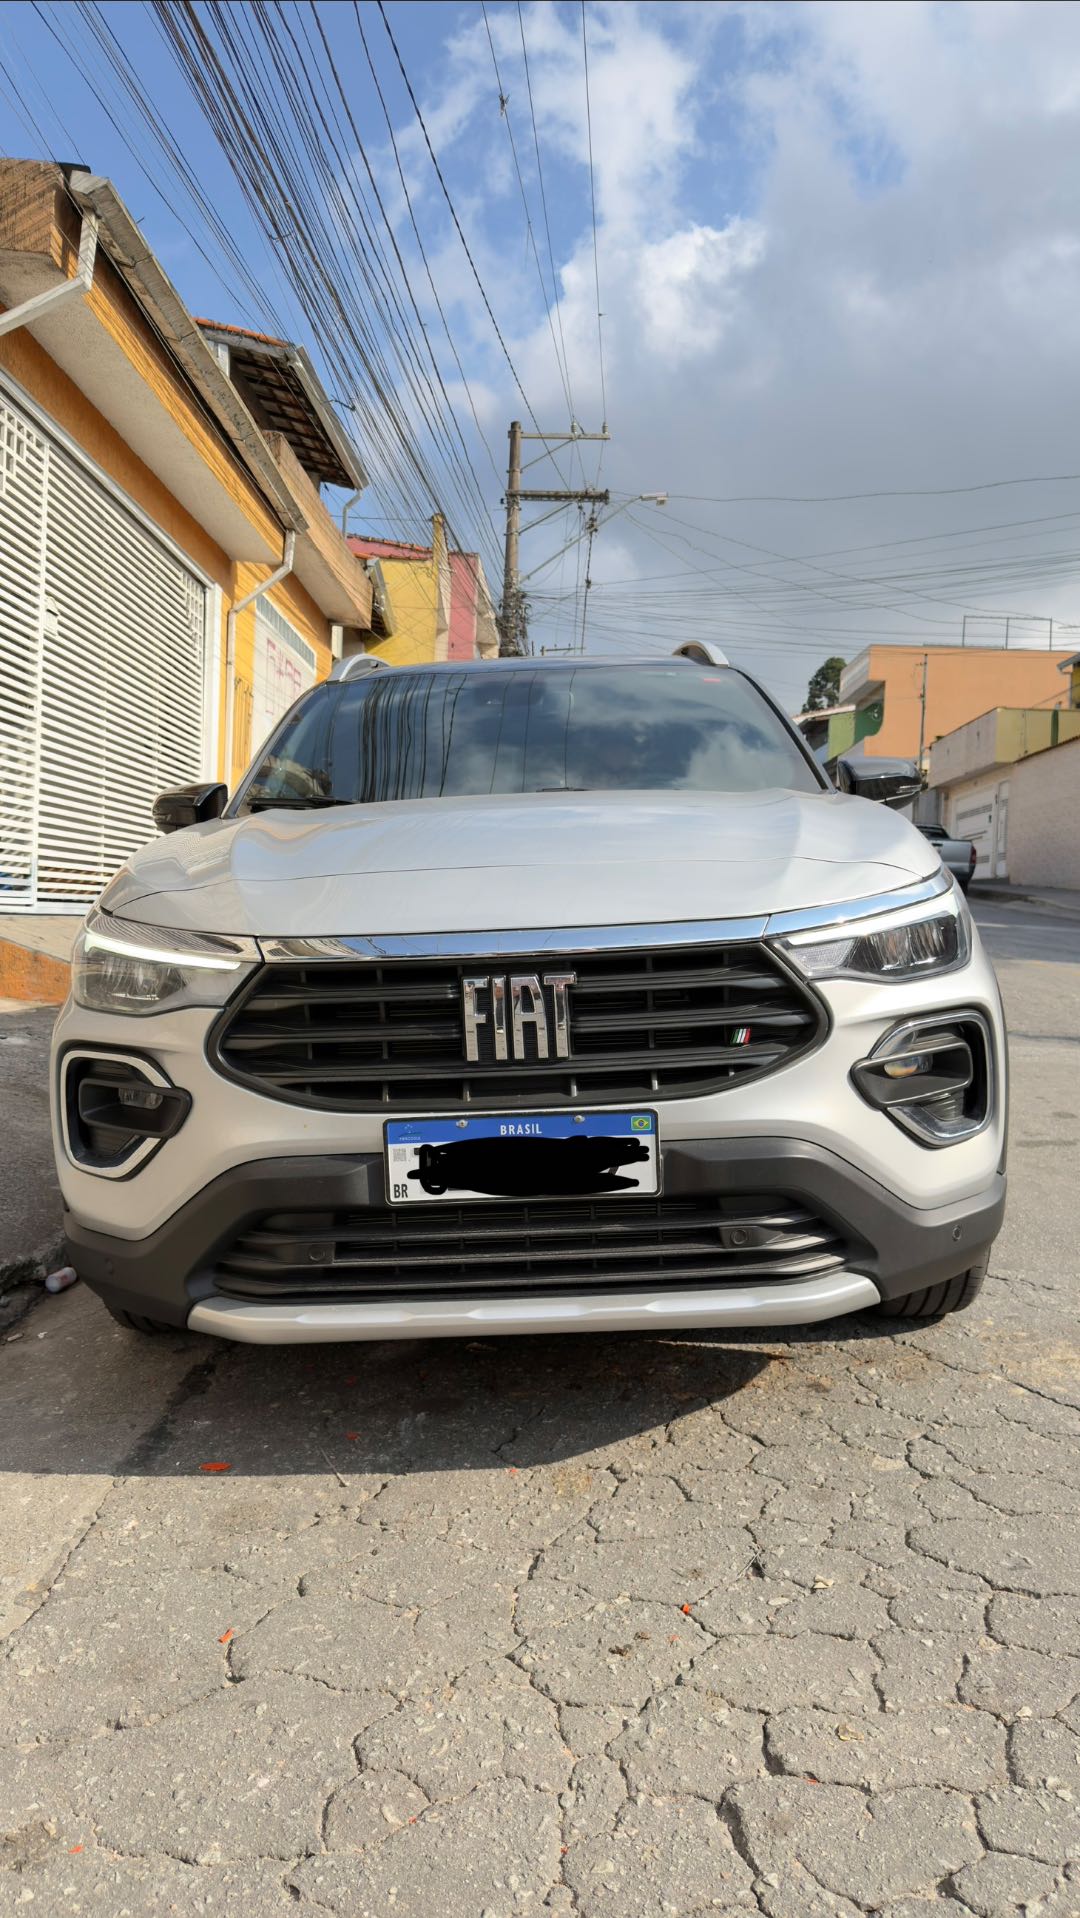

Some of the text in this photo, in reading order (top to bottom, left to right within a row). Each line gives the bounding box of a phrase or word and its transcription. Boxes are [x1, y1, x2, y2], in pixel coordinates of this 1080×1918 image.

[462, 973, 577, 1062] FIAT
[500, 1123, 542, 1136] BRASIL
[393, 1184, 408, 1198] BR
